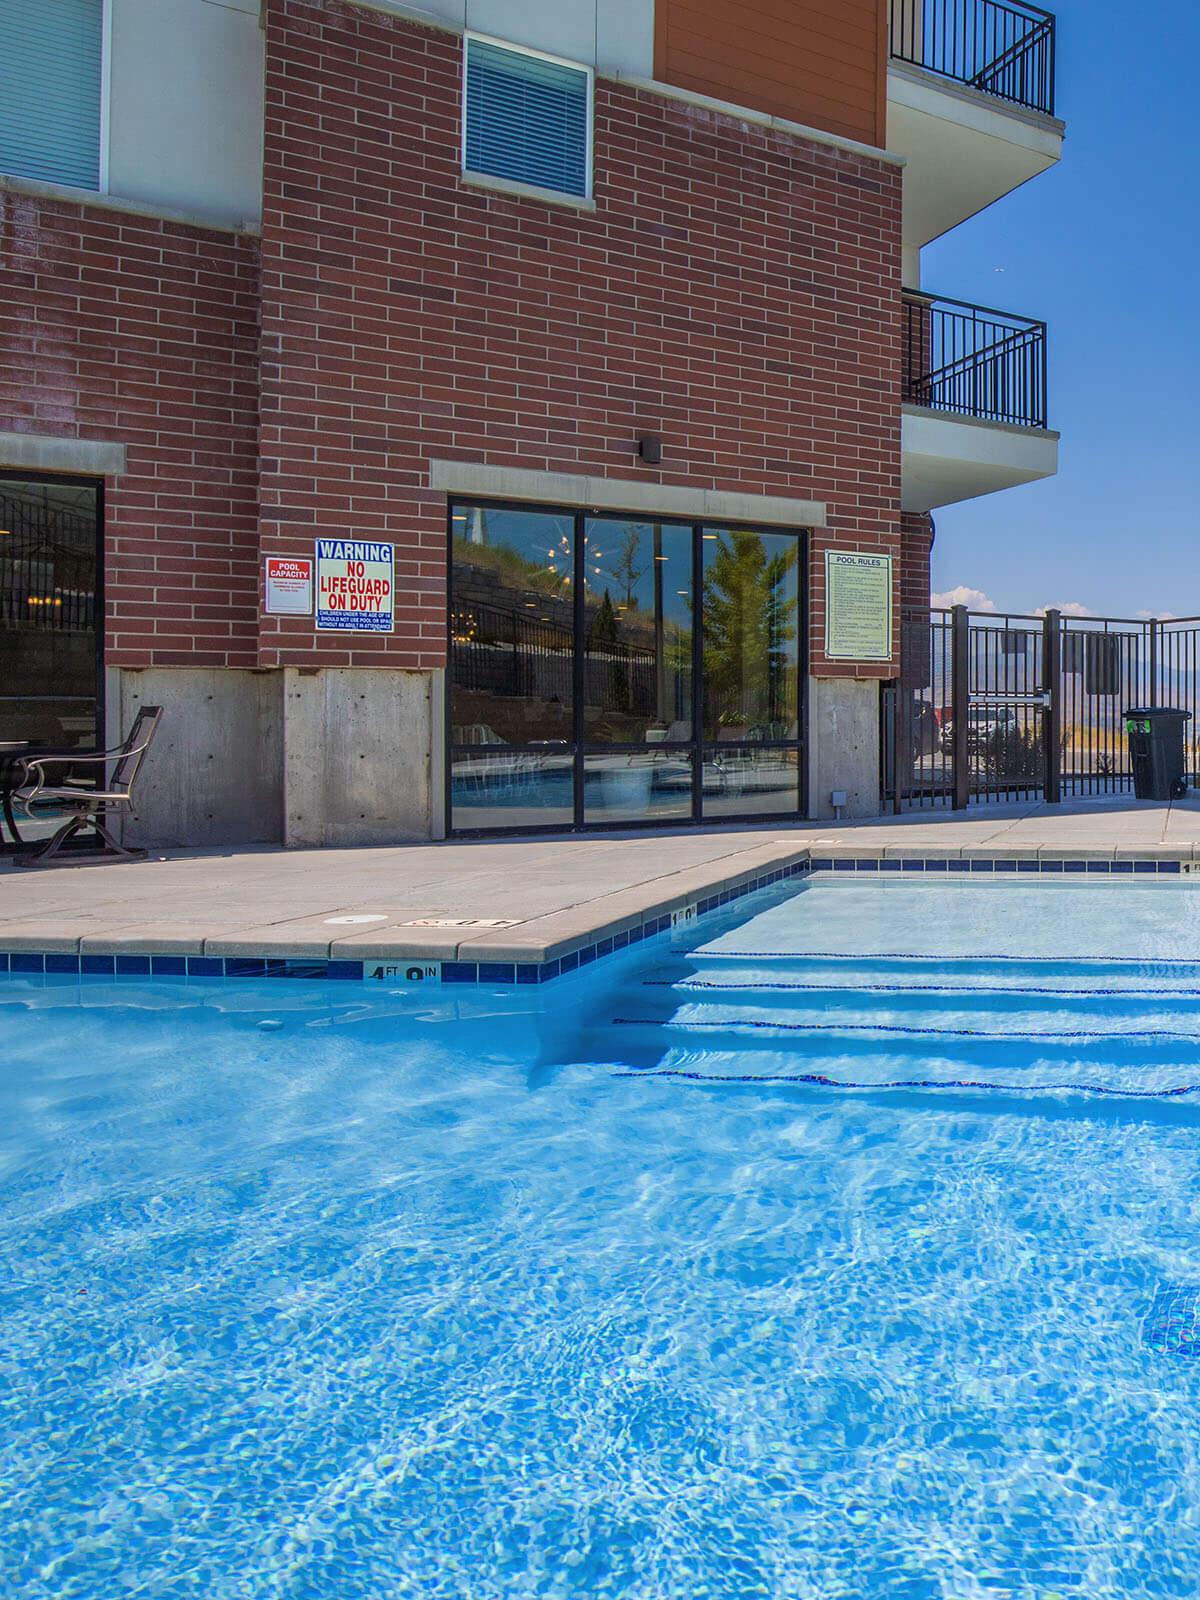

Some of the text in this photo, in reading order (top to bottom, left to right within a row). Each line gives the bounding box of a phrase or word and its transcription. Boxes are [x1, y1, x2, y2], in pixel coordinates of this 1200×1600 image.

[320, 541, 391, 562] WARNING
[279, 563, 300, 571] POOL
[836, 556, 856, 565] POOL
[270, 570, 308, 579] CAPACITY
[347, 561, 365, 577] NO
[321, 576, 390, 596] LIFEGUARD
[328, 594, 382, 612] ON DUTY
[368, 966, 384, 980] 4
[386, 966, 398, 977] FT
[425, 967, 436, 977] IN
